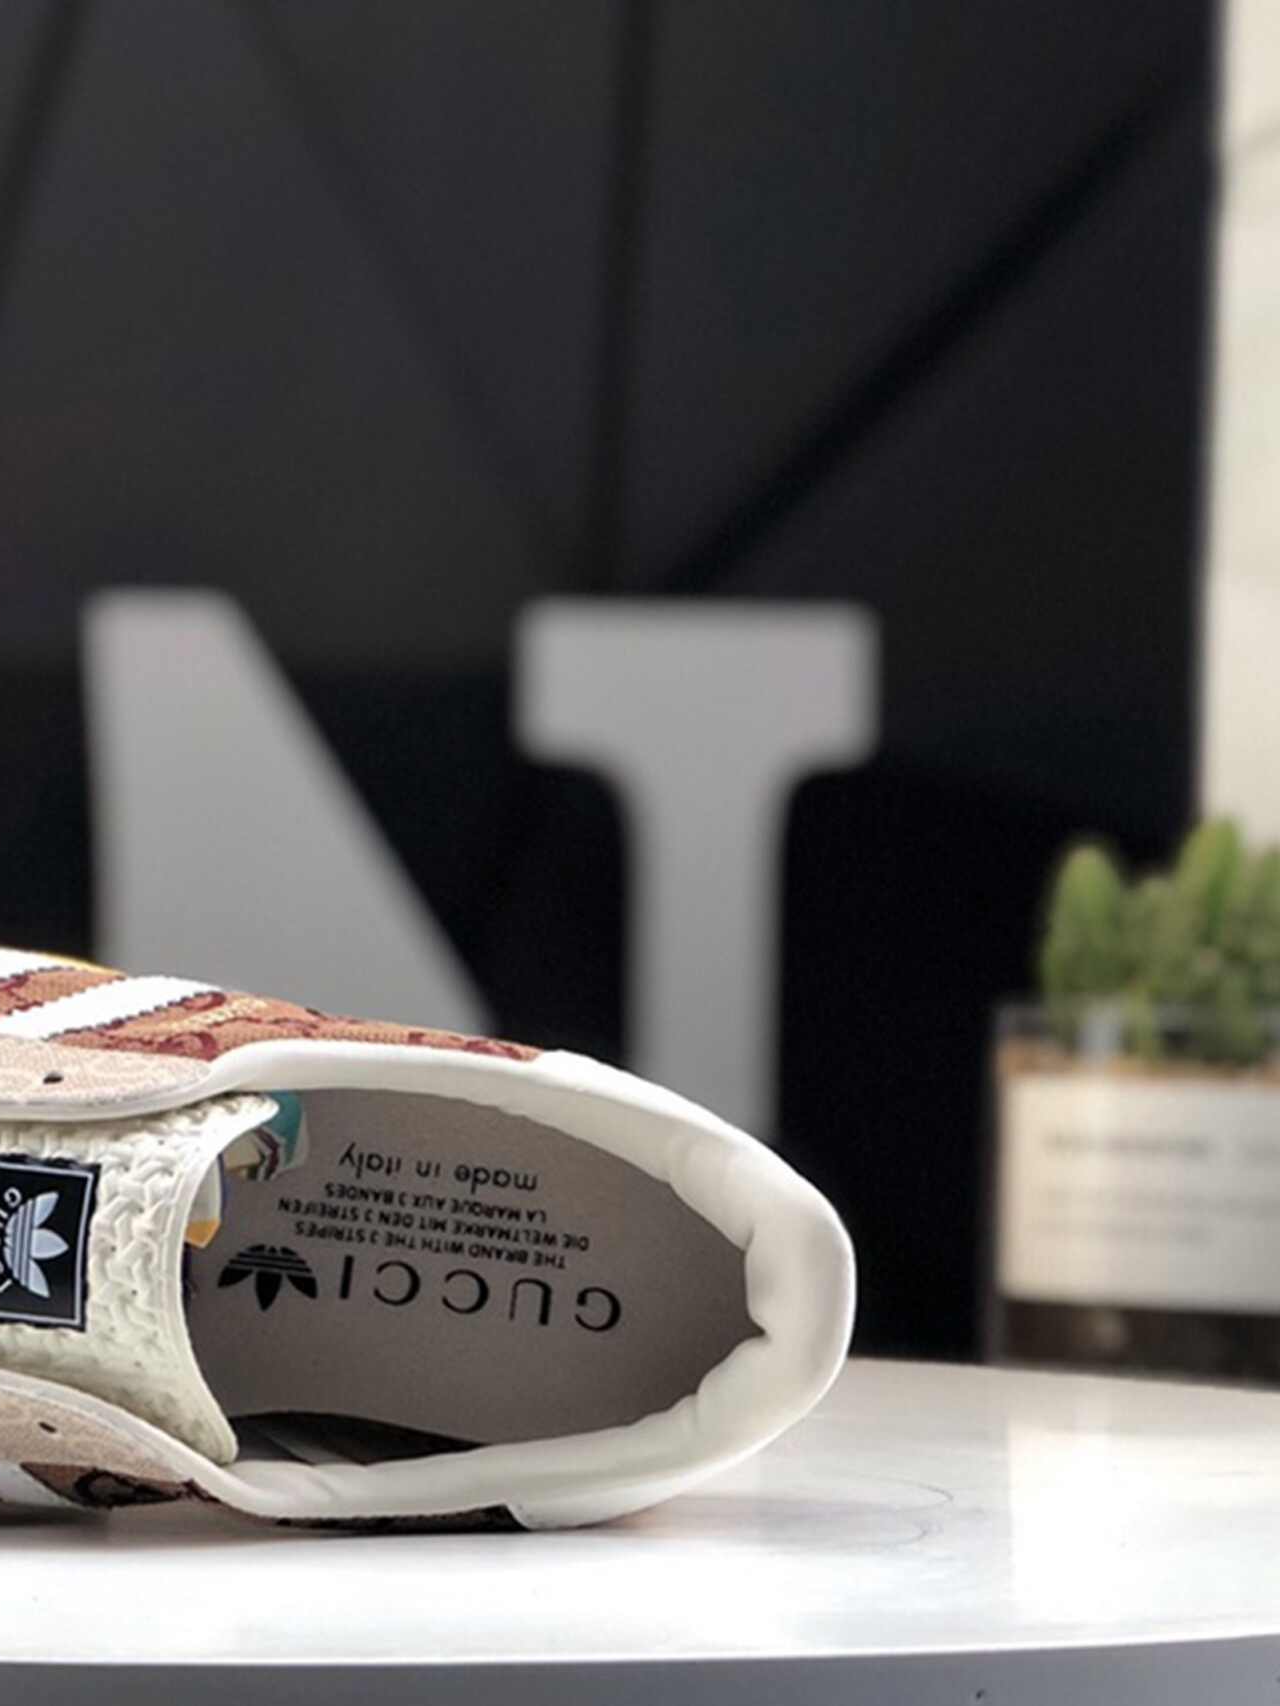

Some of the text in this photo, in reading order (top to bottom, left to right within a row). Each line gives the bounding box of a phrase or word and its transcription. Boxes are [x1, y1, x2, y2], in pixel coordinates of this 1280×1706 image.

[339, 1141, 538, 1195] made in italy
[277, 1197, 590, 1251] DIE WELTMARKE MIT DEN 3 STREIFEN
[324, 1182, 547, 1223] LA MARQUE AUX 3 BANDES
[294, 1220, 566, 1270] THE BRAND WITH THE 3 STRIPES
[339, 1254, 621, 1332] GUCCI
